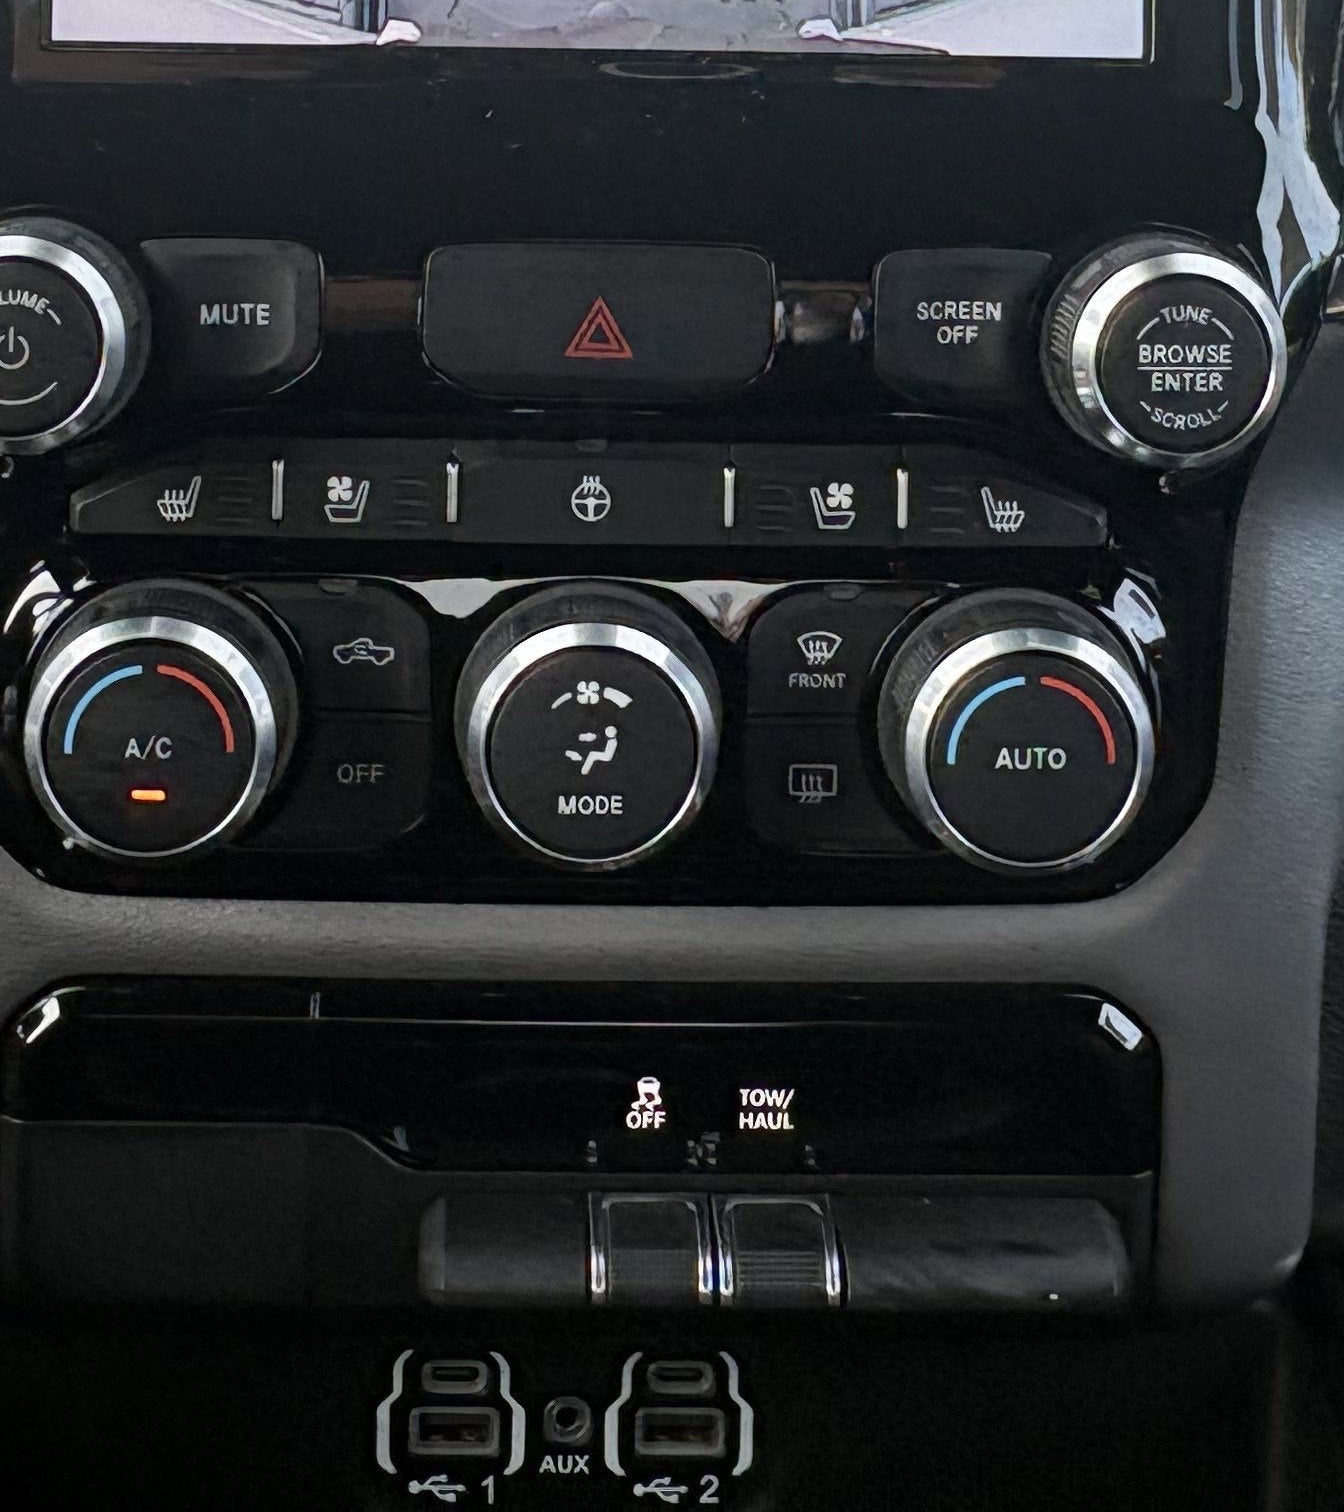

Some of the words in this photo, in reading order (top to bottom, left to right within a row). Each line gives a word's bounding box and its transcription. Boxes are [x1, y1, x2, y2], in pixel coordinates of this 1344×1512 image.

[200, 302, 271, 326] MUTE
[916, 300, 1002, 322] SCREEN
[1159, 305, 1213, 326] TUNE
[936, 324, 979, 344] OFF
[1138, 343, 1233, 364] BROWSE
[1151, 371, 1223, 392] ENTER
[1151, 407, 1224, 430] SCROLL
[788, 672, 847, 689] FRONT
[124, 735, 172, 760] A/C
[994, 747, 1067, 770] AUTO
[336, 763, 385, 784] OFF
[557, 795, 623, 815] MODE
[739, 1088, 795, 1110] TOW/
[625, 1109, 666, 1130] OFF
[739, 1111, 794, 1130] HAUL
[538, 1454, 590, 1475] AUX
[480, 1474, 495, 1505] 1
[699, 1474, 720, 1504] 2
